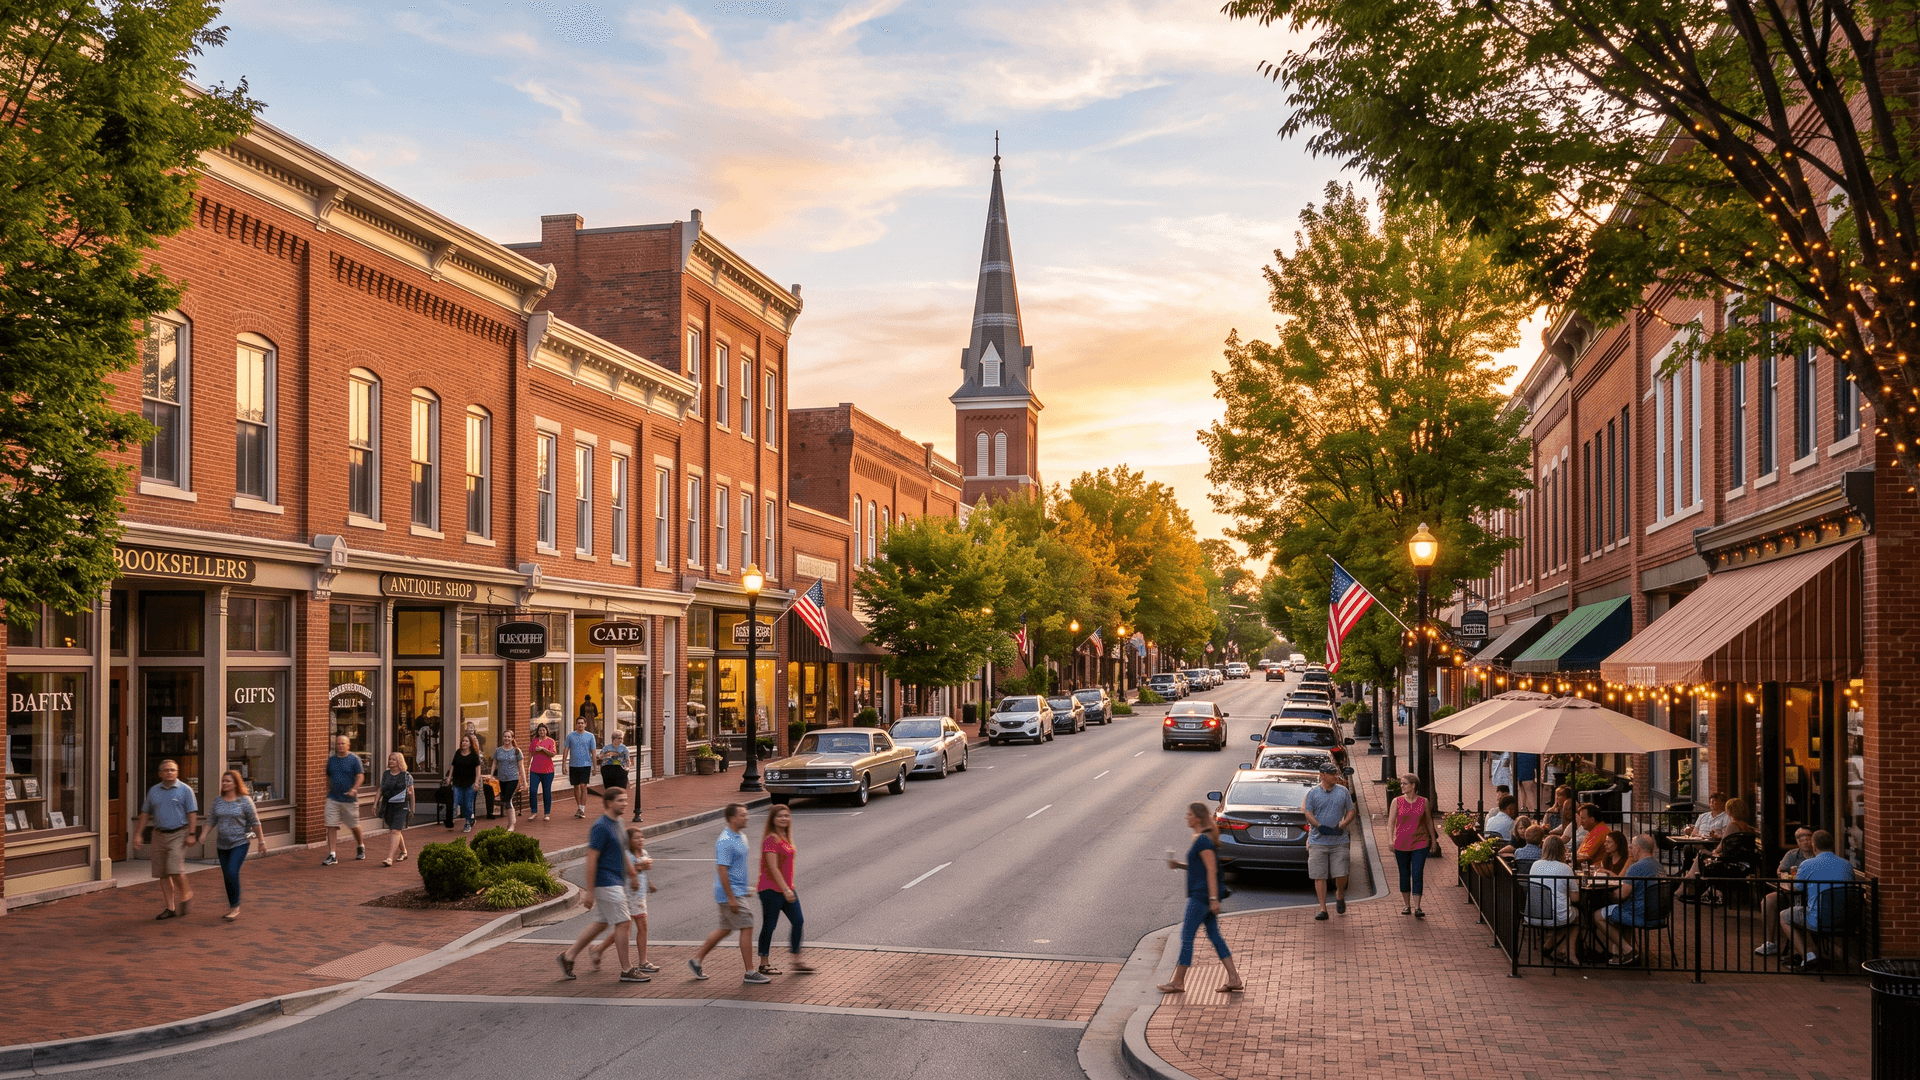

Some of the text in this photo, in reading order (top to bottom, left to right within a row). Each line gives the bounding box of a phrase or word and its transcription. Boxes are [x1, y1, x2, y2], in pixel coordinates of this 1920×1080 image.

[112, 547, 247, 579] BOOKSELLERS
[390, 577, 472, 598] ANTIQUE SHOP
[593, 627, 639, 641] CAFE
[234, 687, 275, 704] GIFTS
